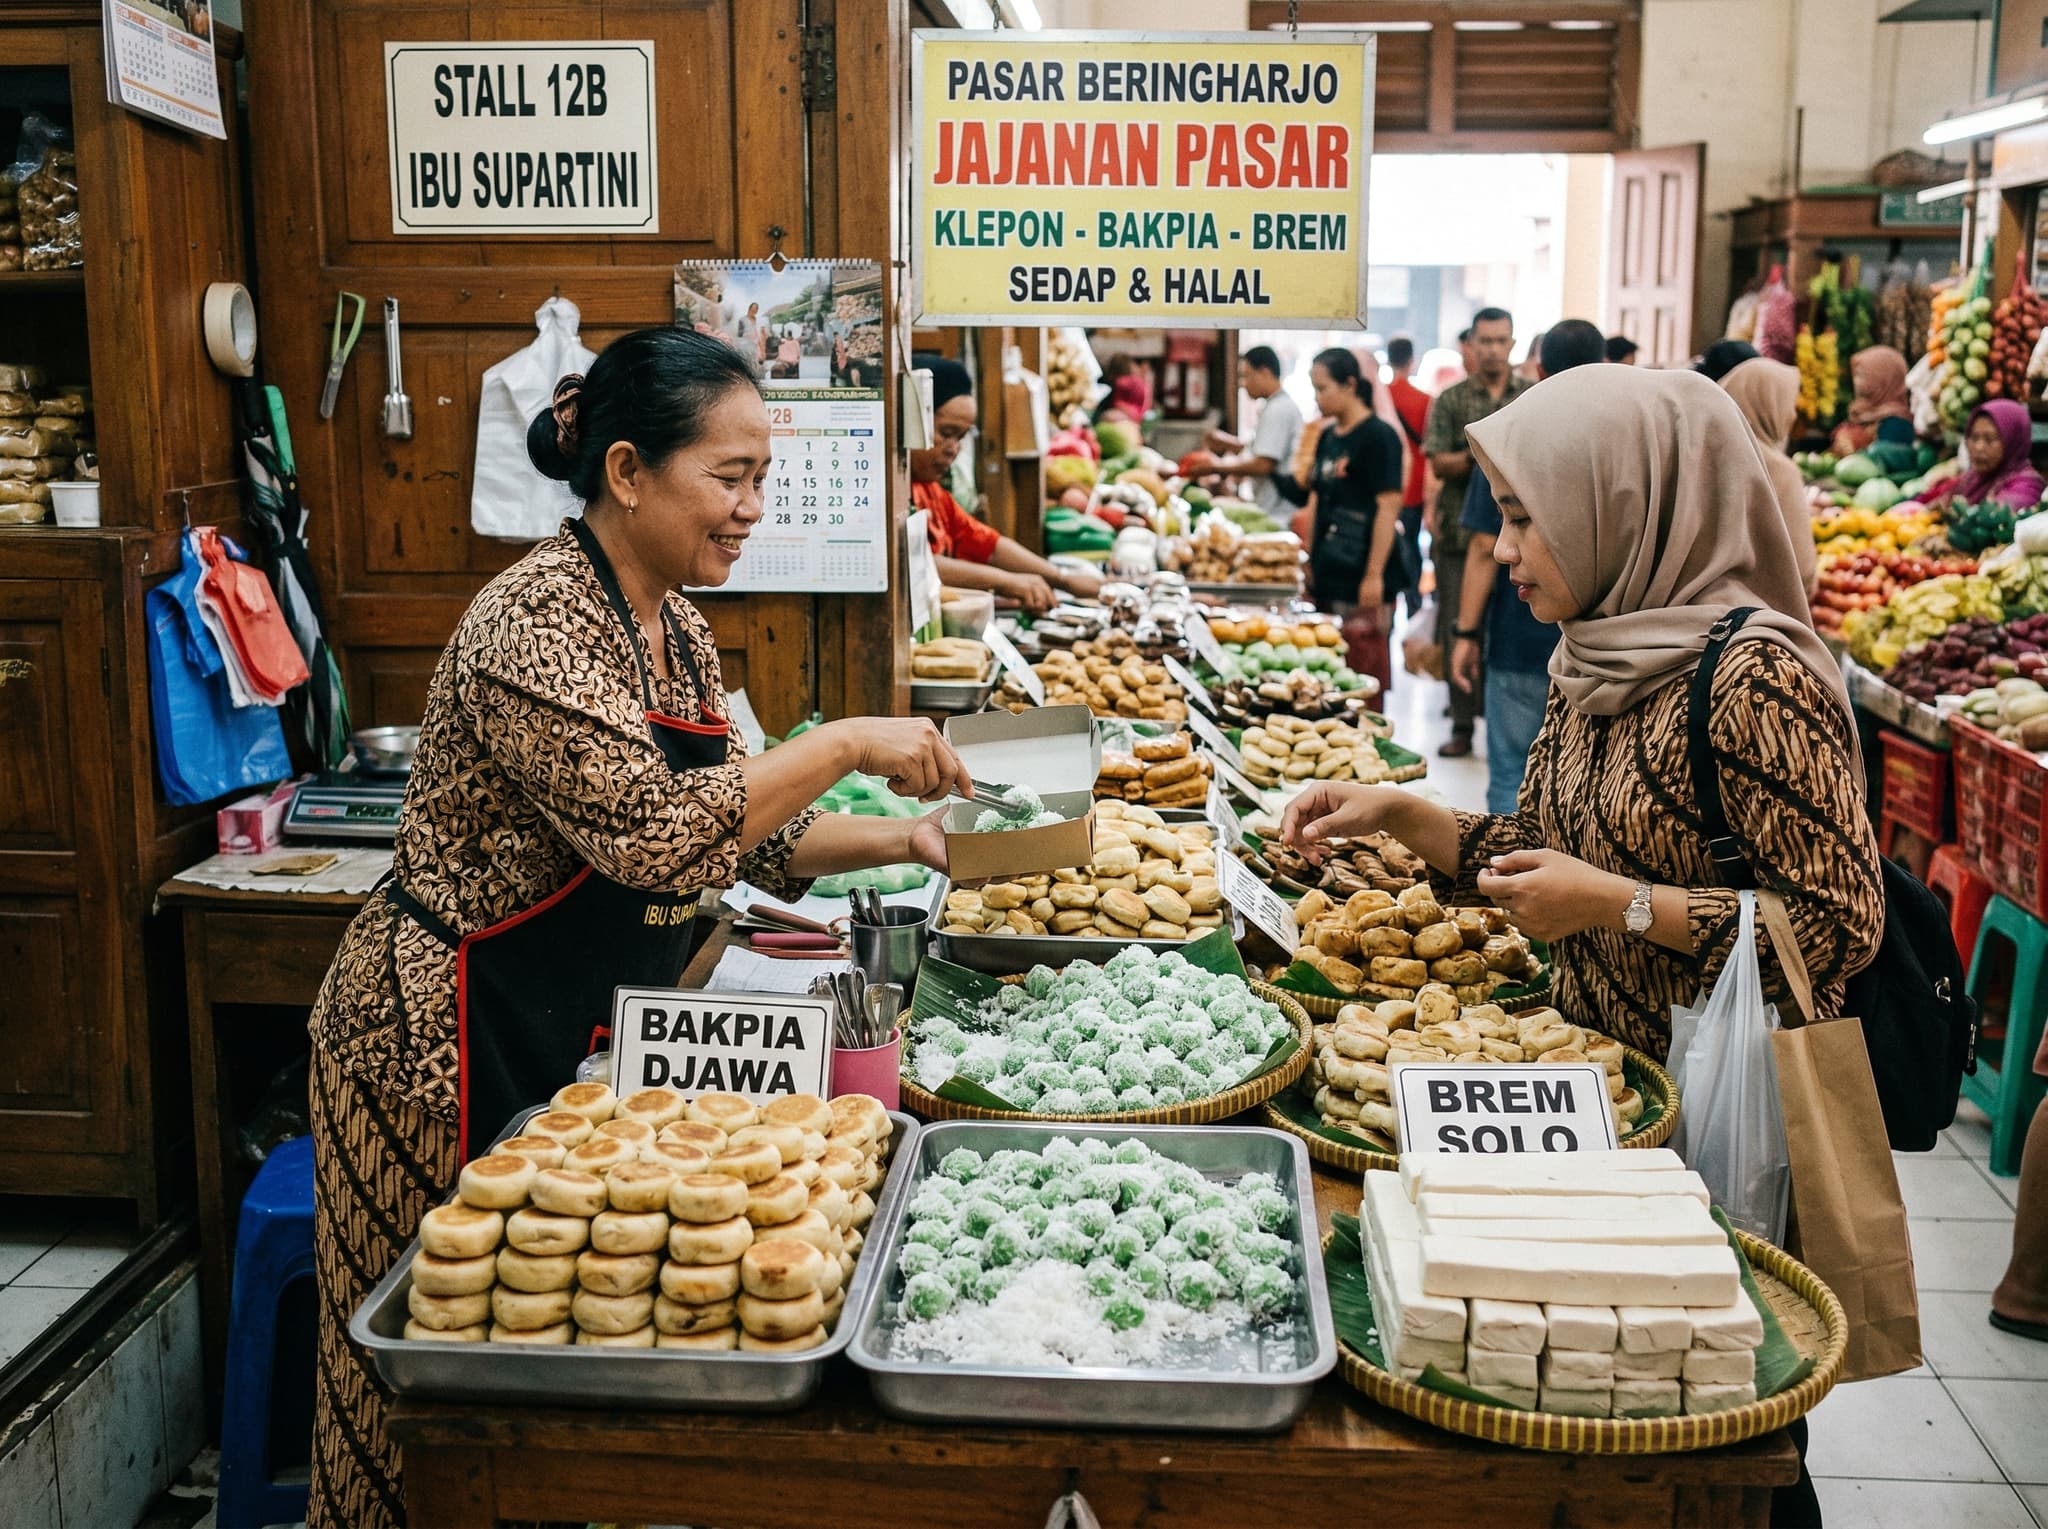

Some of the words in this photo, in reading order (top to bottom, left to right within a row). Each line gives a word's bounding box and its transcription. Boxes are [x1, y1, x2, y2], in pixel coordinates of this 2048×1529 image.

[434, 63, 537, 118] STALL
[546, 63, 608, 117] 12B
[948, 61, 1065, 101] PASAR
[1078, 62, 1338, 104] BERINGHARJO
[933, 121, 1159, 187] JAJANAN
[1176, 123, 1349, 188] PASAR
[409, 151, 462, 209] IBU
[473, 151, 639, 209] SUPARTINI
[935, 210, 1064, 248] KLEPON
[1075, 229, 1087, 238] -
[1098, 211, 1219, 249] BAKPIA
[1229, 231, 1241, 240] -
[1252, 213, 1347, 251] BREM
[1009, 266, 1116, 302] SEDAP
[1128, 267, 1152, 304] &
[1164, 268, 1271, 305] HALAL
[768, 408, 793, 424] 2B
[806, 441, 811, 452] 1
[831, 441, 839, 452] 2
[857, 441, 865, 452] 3
[778, 459, 786, 470] 7
[805, 459, 813, 470] 8
[831, 459, 839, 470] 9
[854, 459, 869, 470] 10
[776, 477, 790, 489] 14
[802, 477, 817, 489] 15
[829, 477, 843, 489] 16
[854, 477, 869, 489] 17
[775, 495, 789, 507] 21
[801, 495, 817, 507] 22
[828, 495, 843, 507] 23
[853, 495, 869, 507] 24
[775, 513, 791, 525] 28
[802, 513, 818, 525] 29
[828, 513, 844, 525] 30
[643, 903, 669, 926] IBU
[640, 1007, 805, 1050] BAKPIA
[642, 1053, 797, 1095] DJAWA
[1427, 1079, 1576, 1114] BREM
[1437, 1124, 1579, 1153] SOLO
